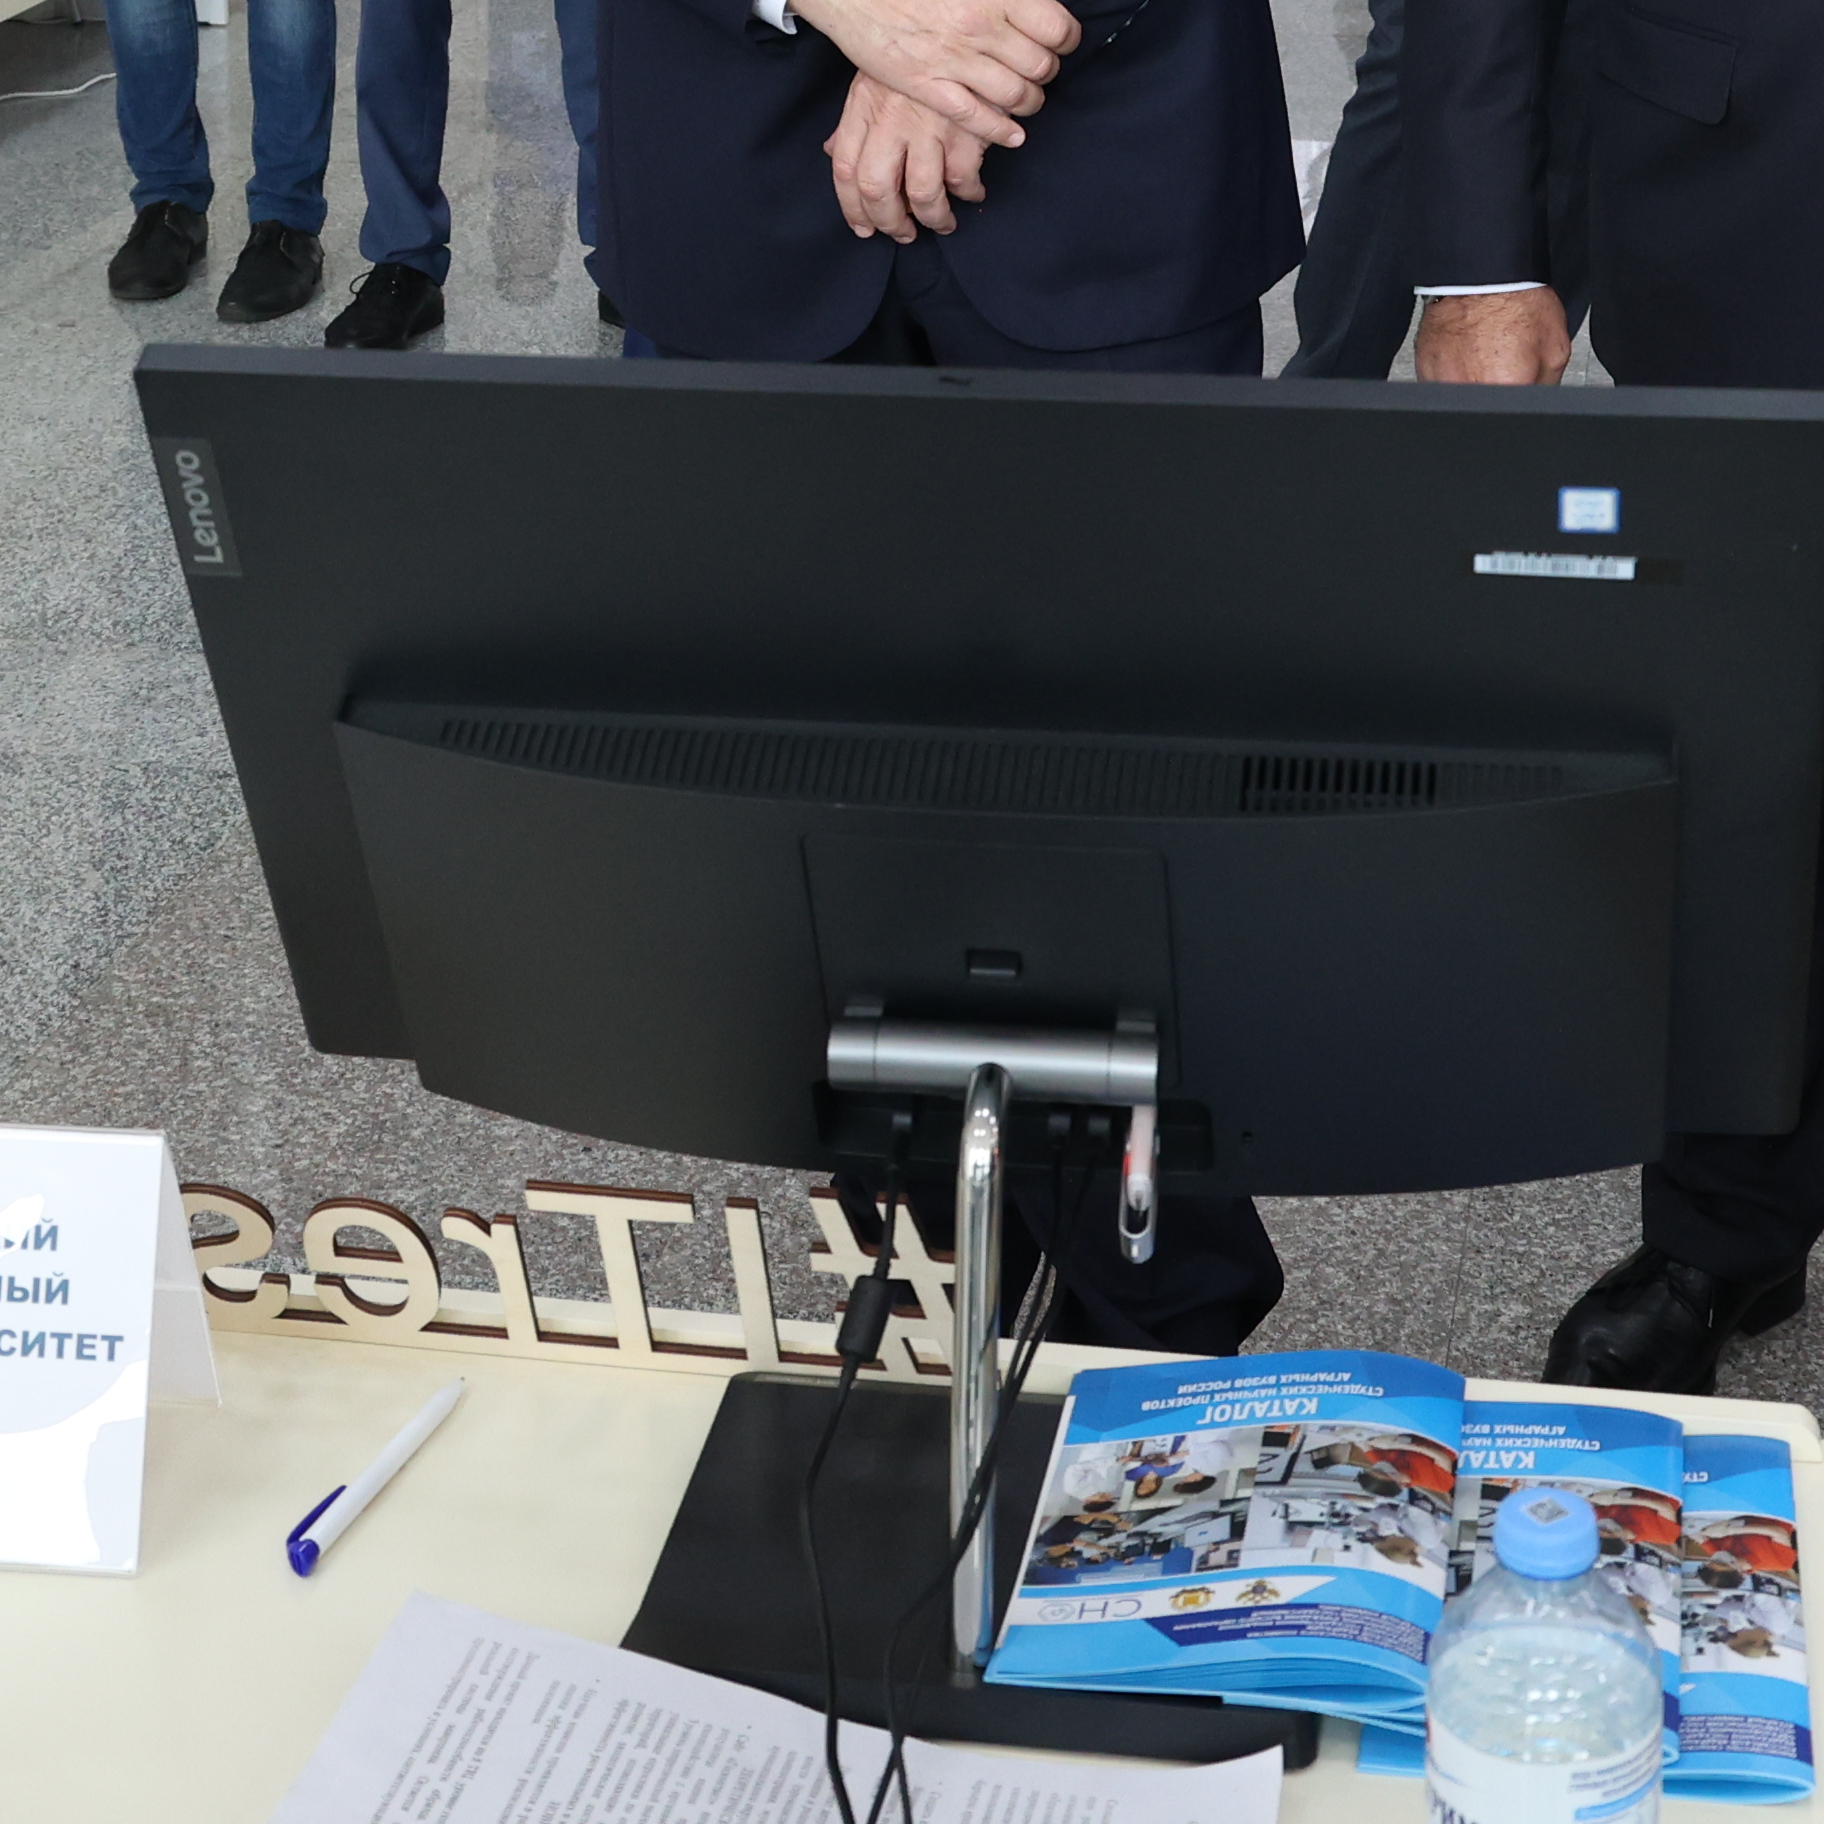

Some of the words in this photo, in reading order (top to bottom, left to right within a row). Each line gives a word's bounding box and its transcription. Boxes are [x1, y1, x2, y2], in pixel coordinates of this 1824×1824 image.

[174, 448, 225, 566] Lenovo
[1280, 1371, 1352, 1384] АГРАРНЫХ
[1178, 1379, 1232, 1395] РОССИИ
[1281, 1384, 1384, 1397] СТУДЕНЧЕСКИХ
[1142, 1393, 1210, 1411] ПРОЕКТОВ
[1197, 1397, 1319, 1424] КАТАЛОГ
